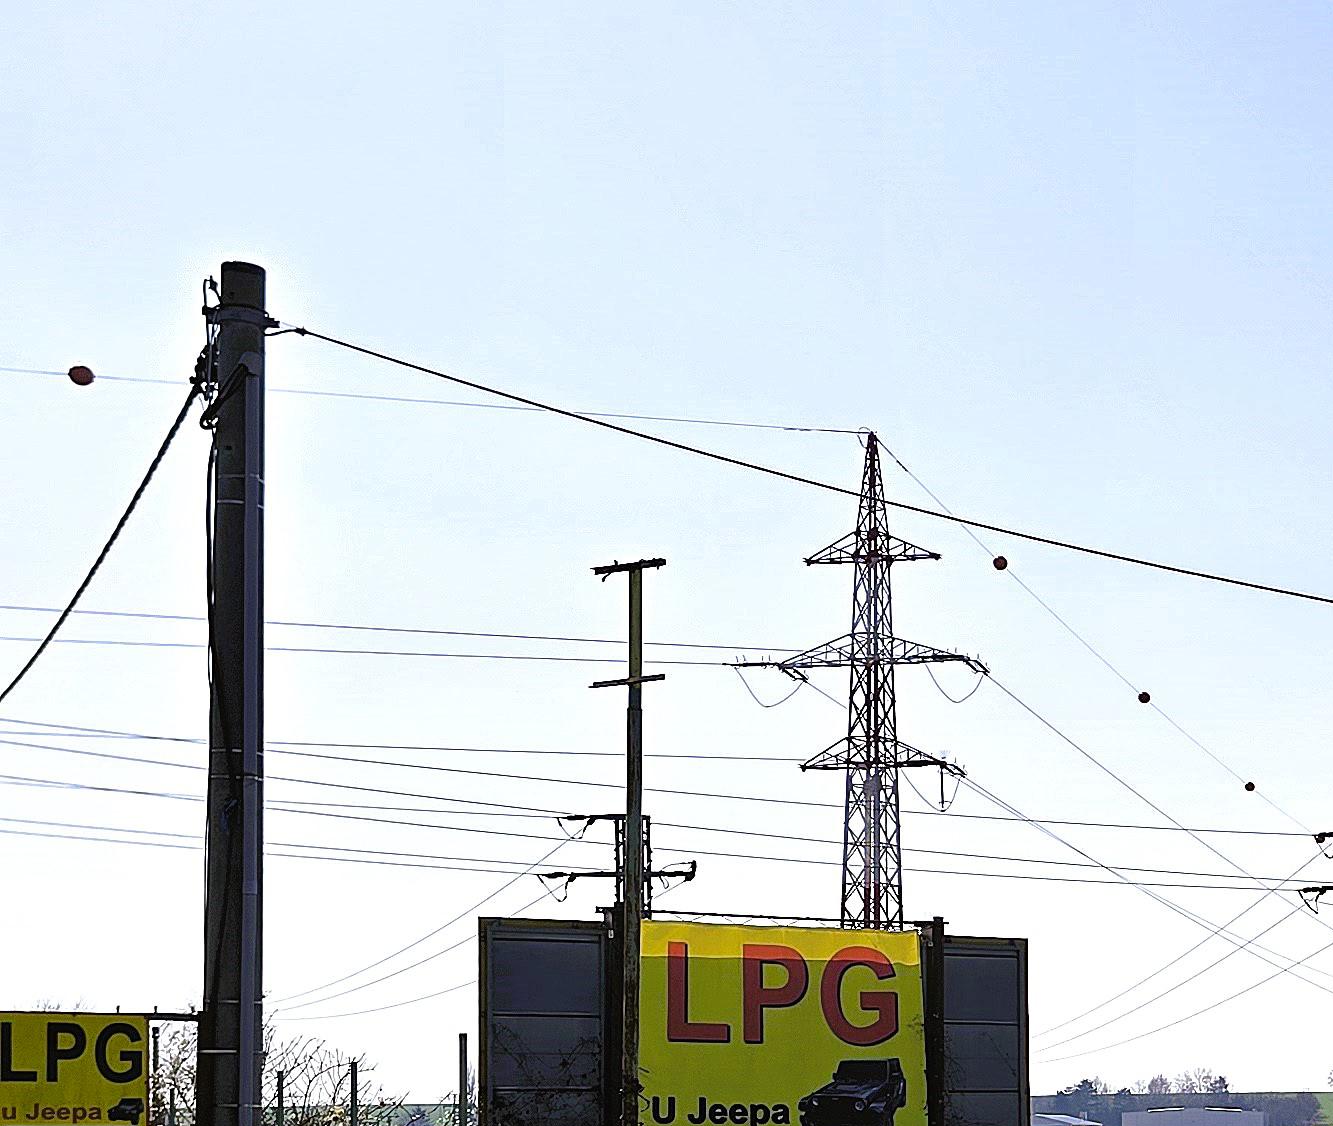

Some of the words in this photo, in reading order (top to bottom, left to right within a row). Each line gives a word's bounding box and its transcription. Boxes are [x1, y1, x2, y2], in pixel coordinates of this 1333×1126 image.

[667, 941, 899, 1046] LPG
[0, 1021, 143, 1083] LPG
[1, 1106, 17, 1120] u
[25, 1103, 102, 1124] Jeepa
[652, 1097, 675, 1124] U
